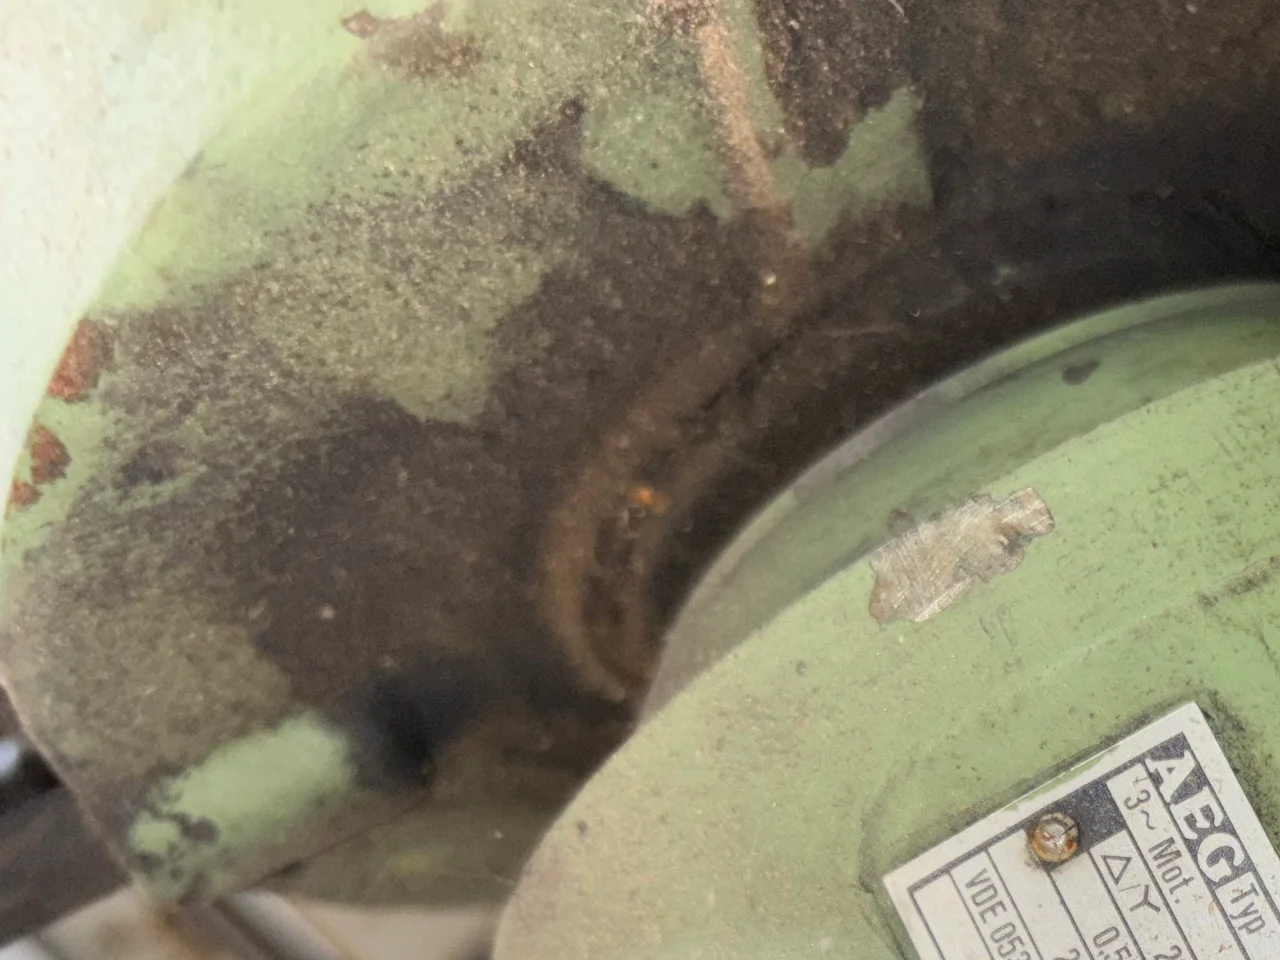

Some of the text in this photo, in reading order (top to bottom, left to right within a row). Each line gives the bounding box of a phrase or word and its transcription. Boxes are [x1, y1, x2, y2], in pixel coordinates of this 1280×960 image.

[1148, 750, 1246, 884] AEG
[963, 867, 1009, 925] VDE
[1147, 835, 1196, 906] Mot.
[1227, 881, 1267, 936] Typ
